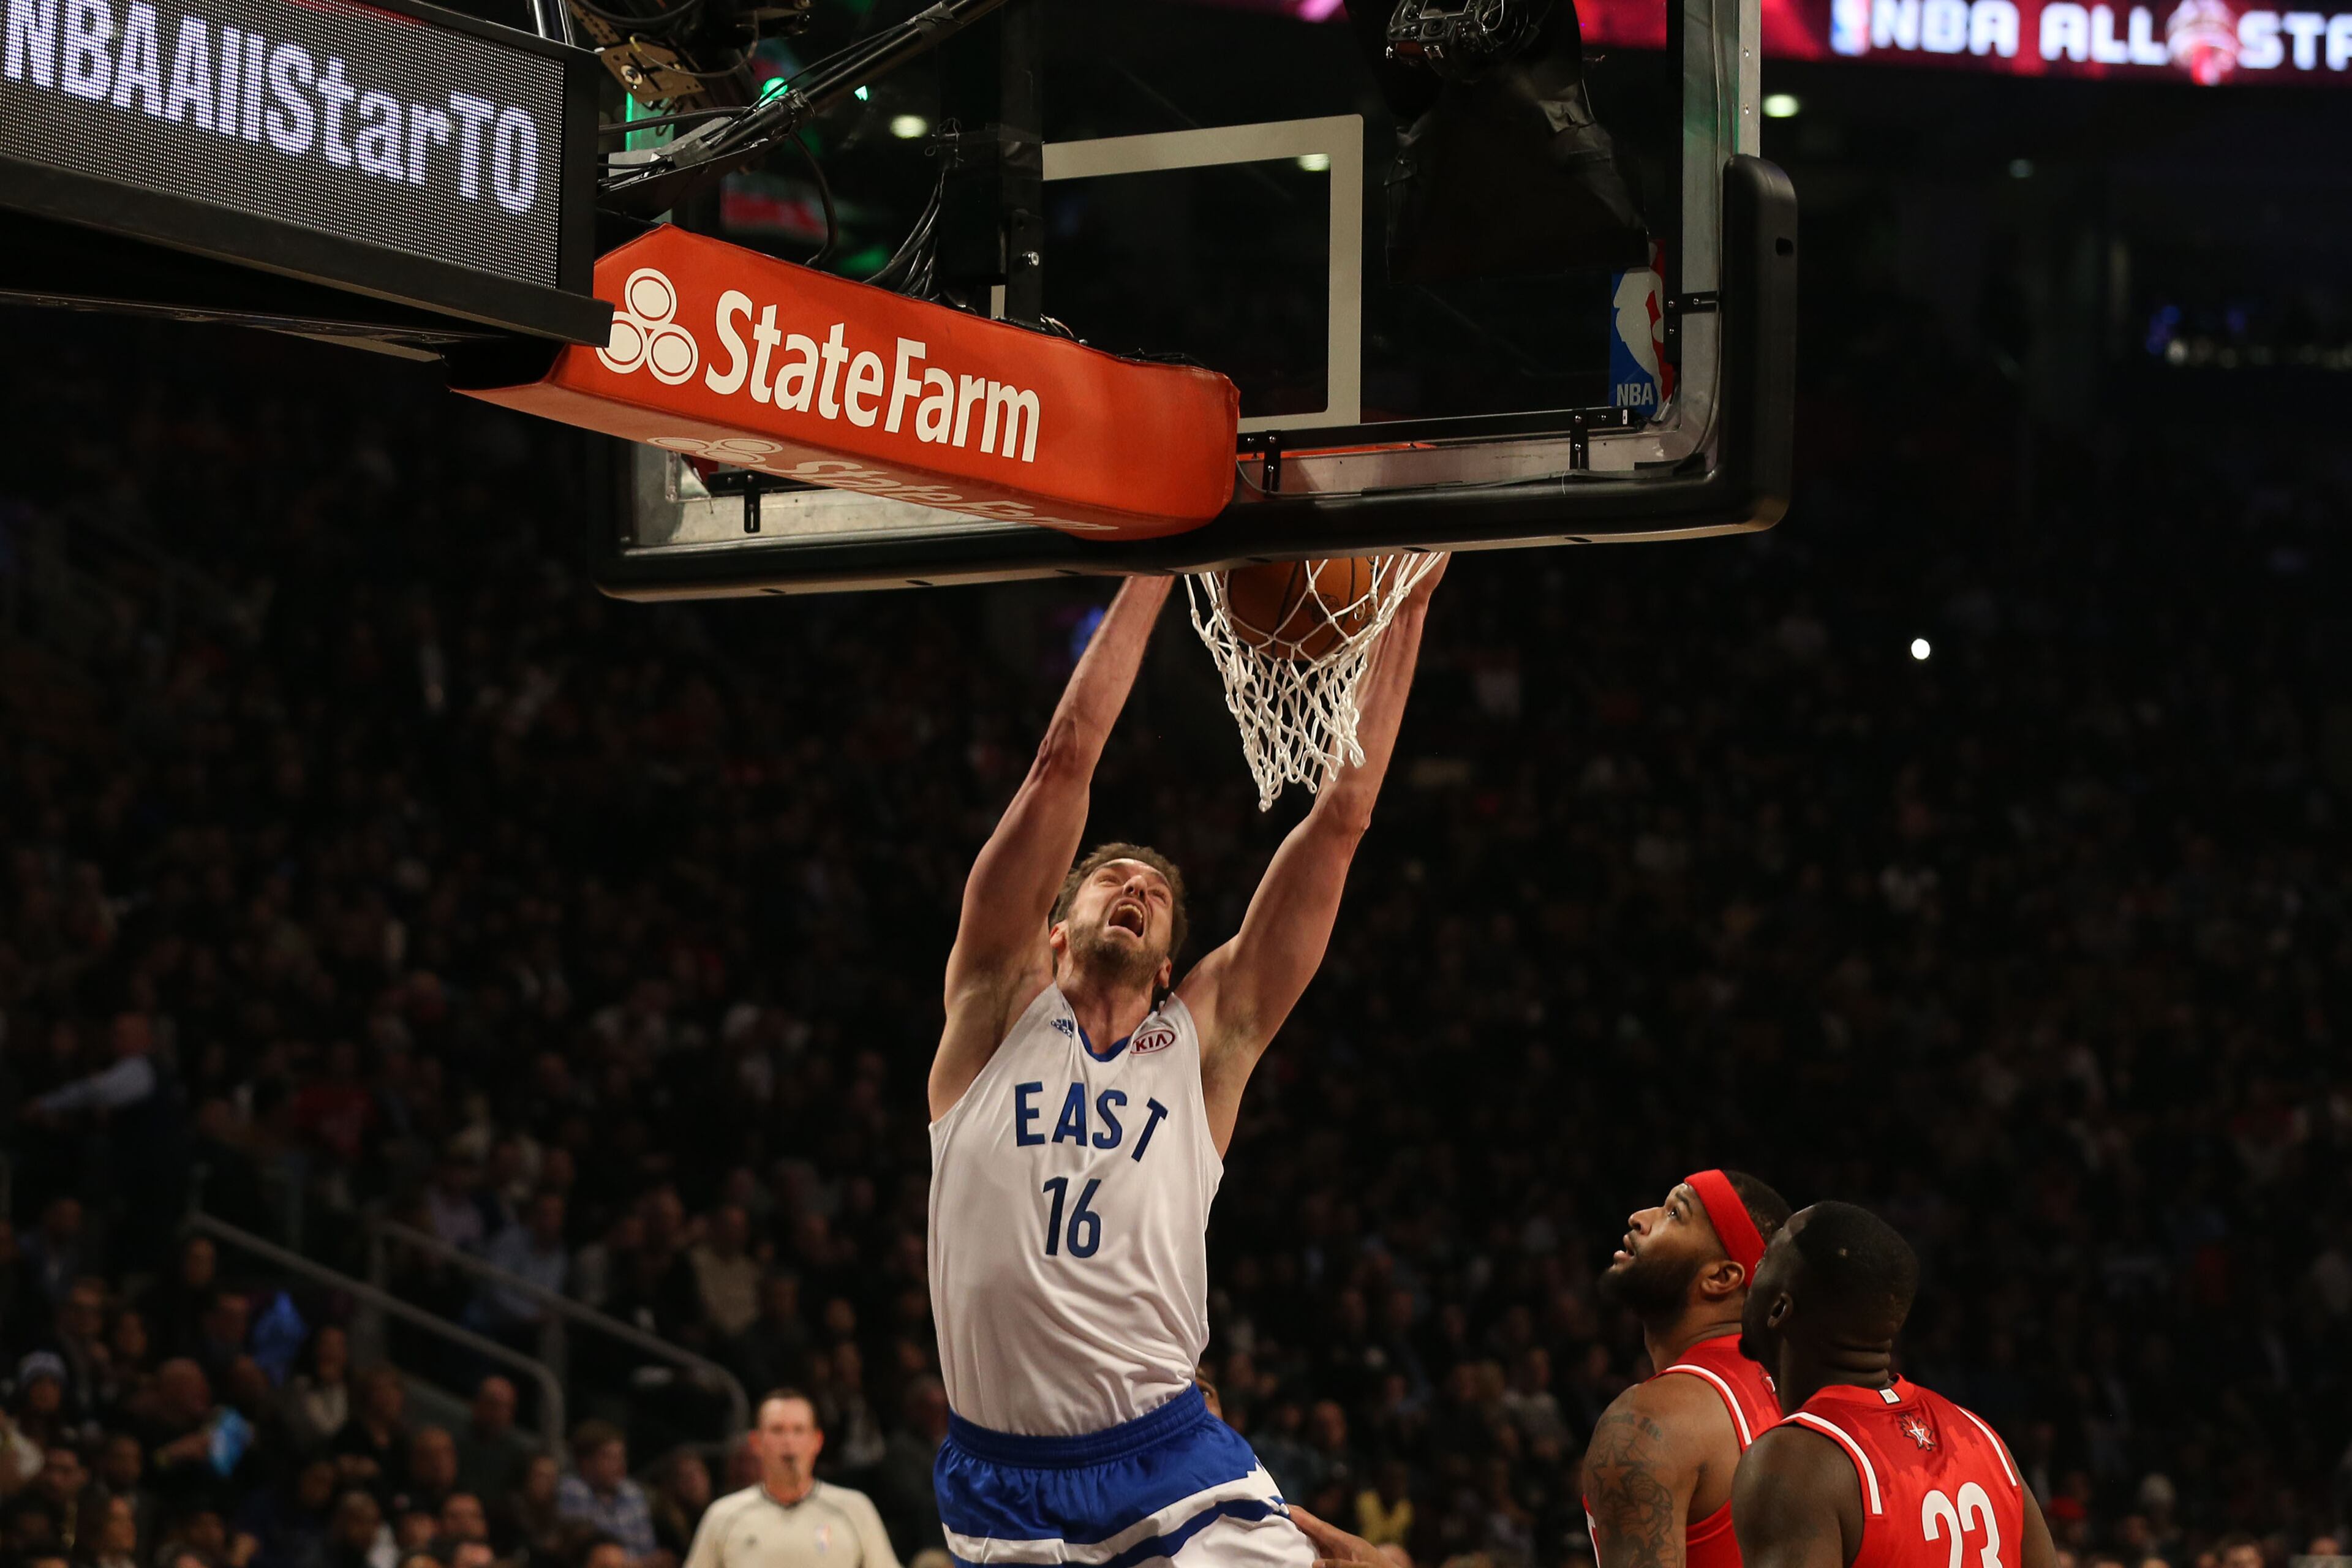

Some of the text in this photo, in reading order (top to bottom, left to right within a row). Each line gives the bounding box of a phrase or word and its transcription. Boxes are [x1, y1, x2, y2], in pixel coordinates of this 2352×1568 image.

[1871, 0, 2019, 58] NBA
[2040, 2, 2168, 66] ALL
[1616, 382, 1654, 407] NBA
[1136, 1033, 1167, 1052] KIA
[1015, 1081, 1168, 1163] EAST
[1042, 1176, 1102, 1258] 16
[1921, 1481, 2003, 1568] 23
